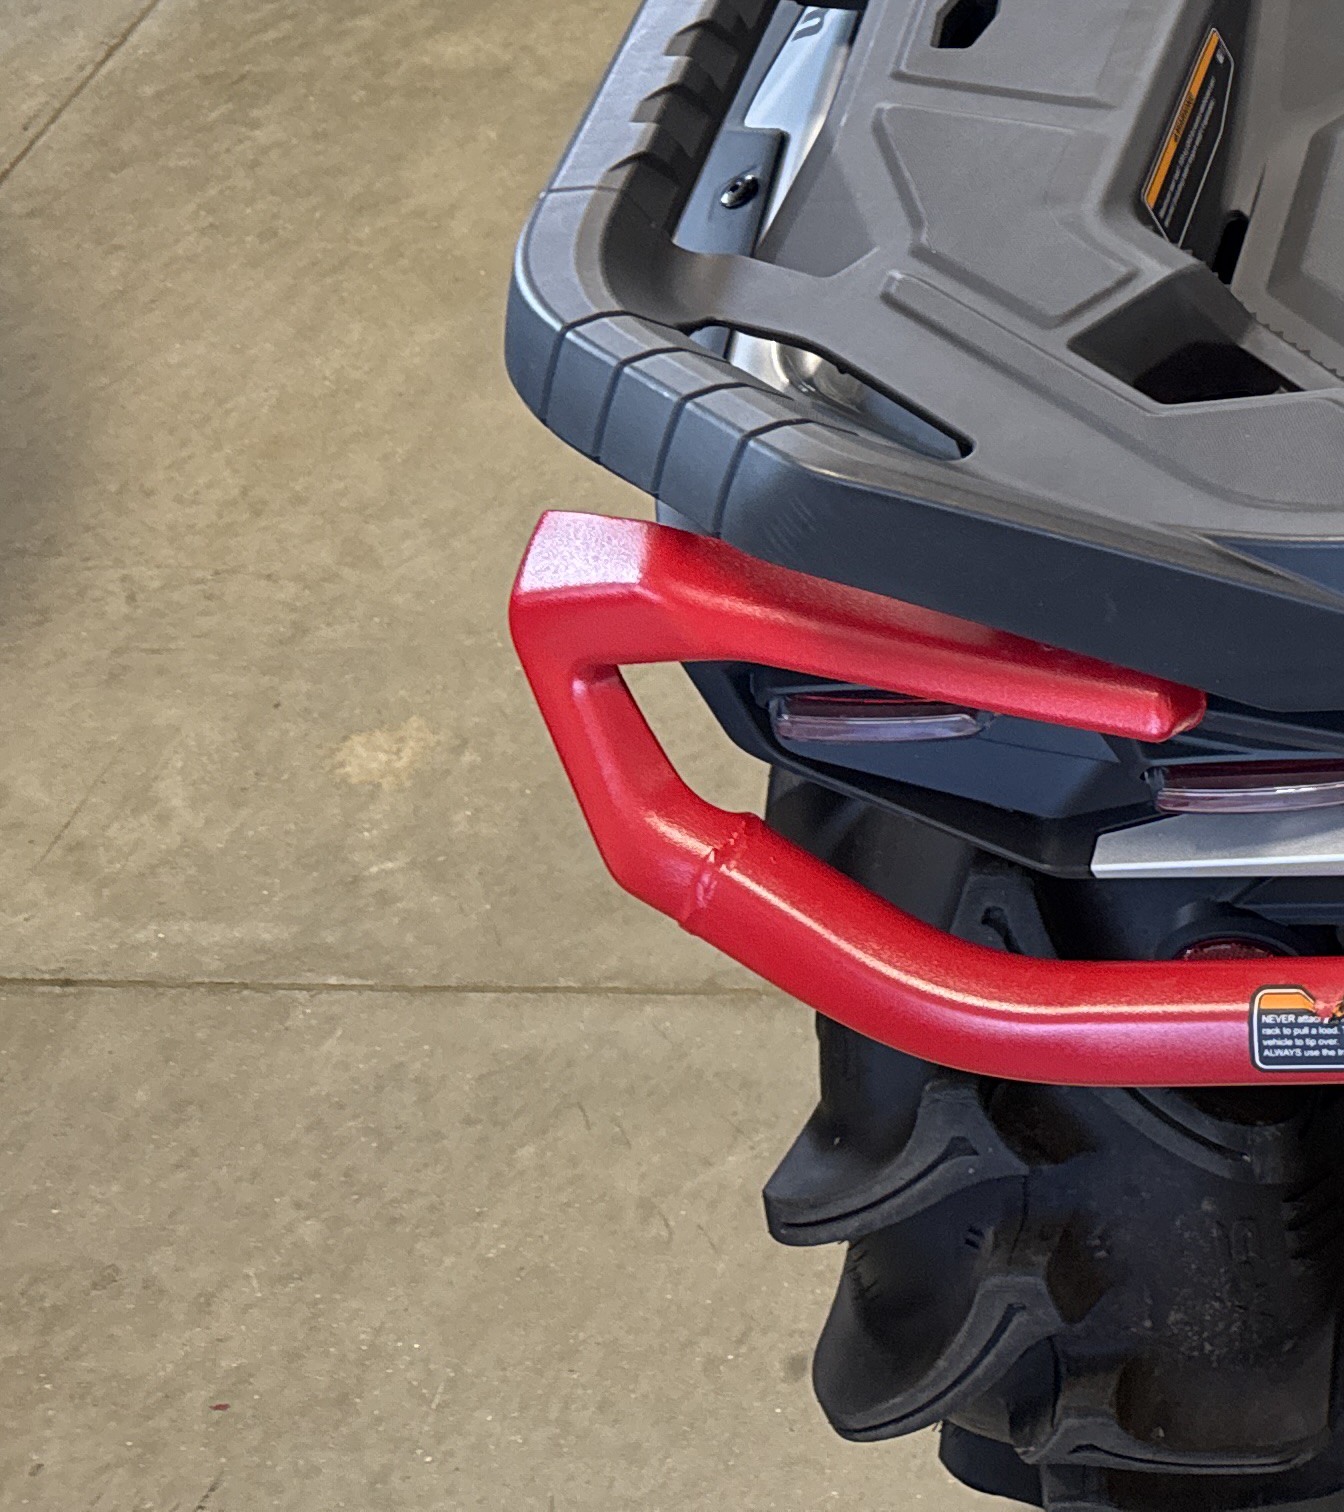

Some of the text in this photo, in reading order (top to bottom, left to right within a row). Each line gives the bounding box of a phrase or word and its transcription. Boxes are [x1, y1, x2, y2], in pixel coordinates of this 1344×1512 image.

[1261, 1014, 1296, 1024] NEVER
[1261, 1026, 1281, 1035] rack
[1282, 1026, 1292, 1035] to
[1293, 1025, 1310, 1036] pull
[1310, 1027, 1318, 1035] a
[1318, 1025, 1340, 1035] load.
[1262, 1037, 1340, 1047] vehicle to tip over.
[1262, 1048, 1303, 1057] ALWAYS
[1303, 1049, 1320, 1057] use
[1321, 1048, 1337, 1057] the
